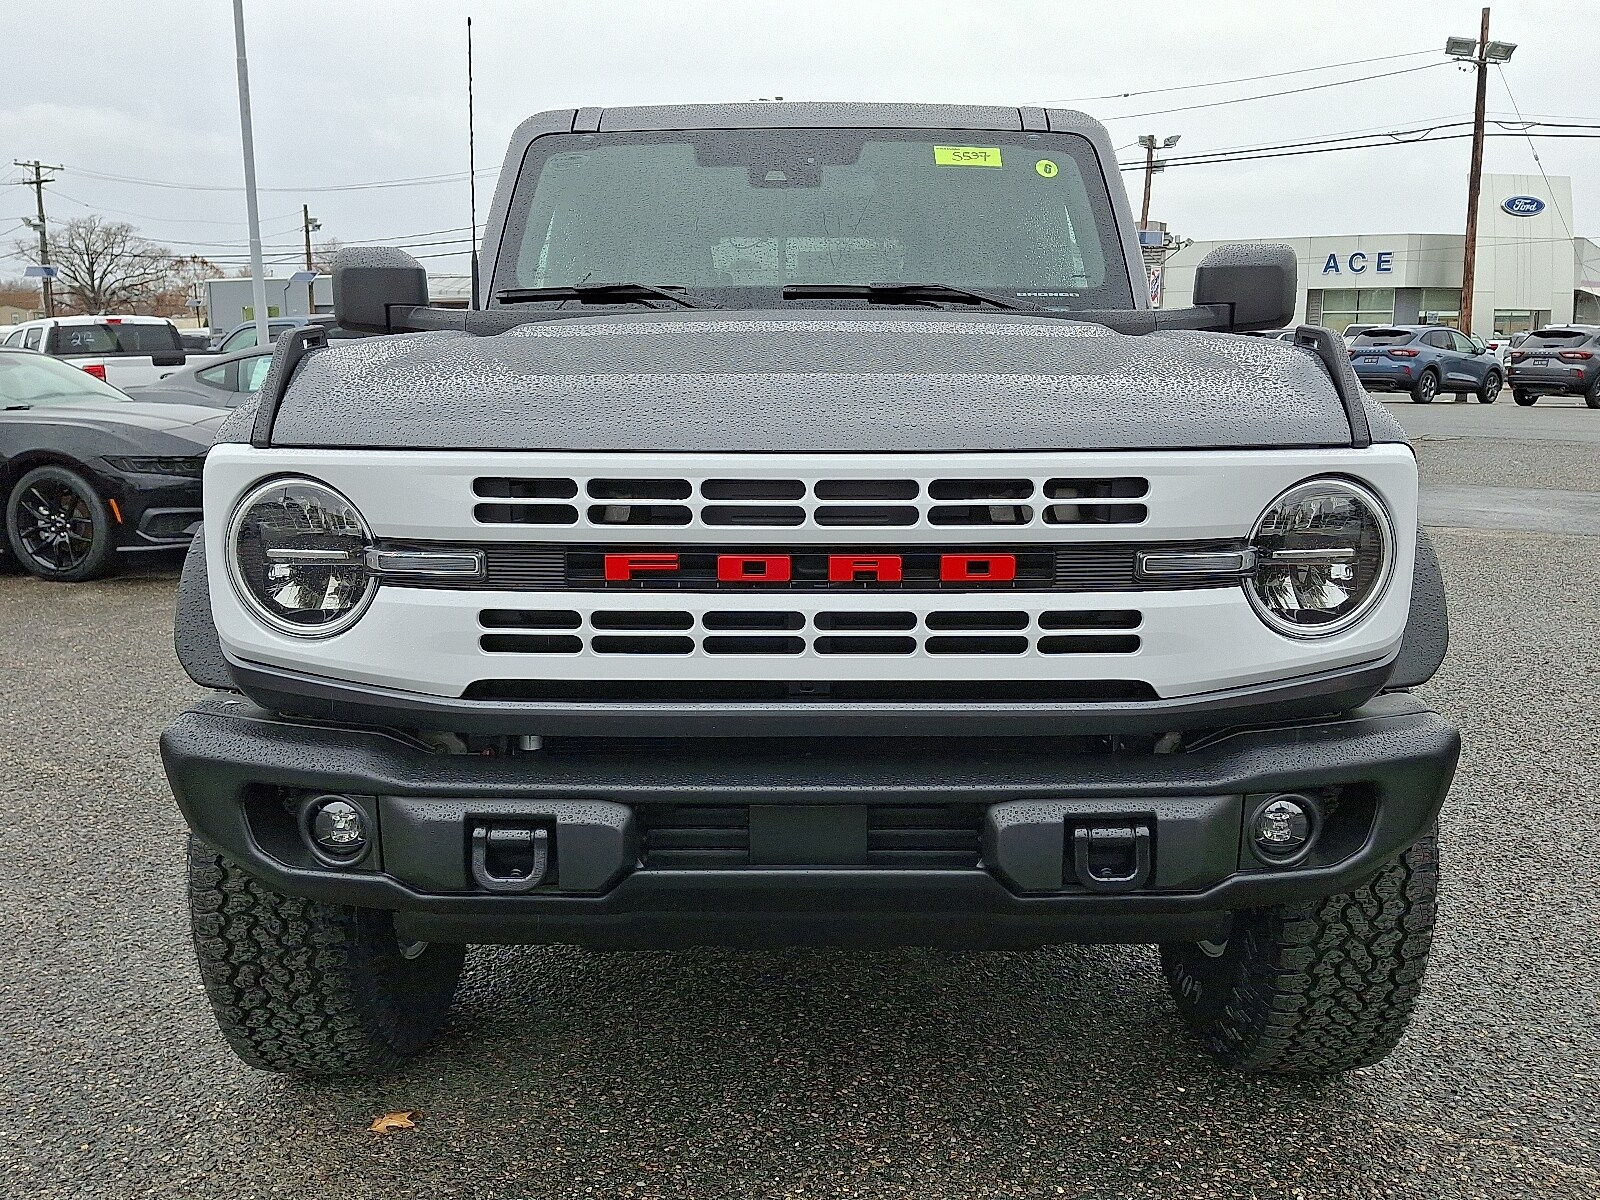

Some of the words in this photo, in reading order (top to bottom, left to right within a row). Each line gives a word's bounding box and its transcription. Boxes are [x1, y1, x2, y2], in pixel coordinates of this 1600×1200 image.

[1512, 198, 1538, 211] Ford
[1322, 251, 1394, 274] ACE
[604, 554, 1016, 582] FORD
